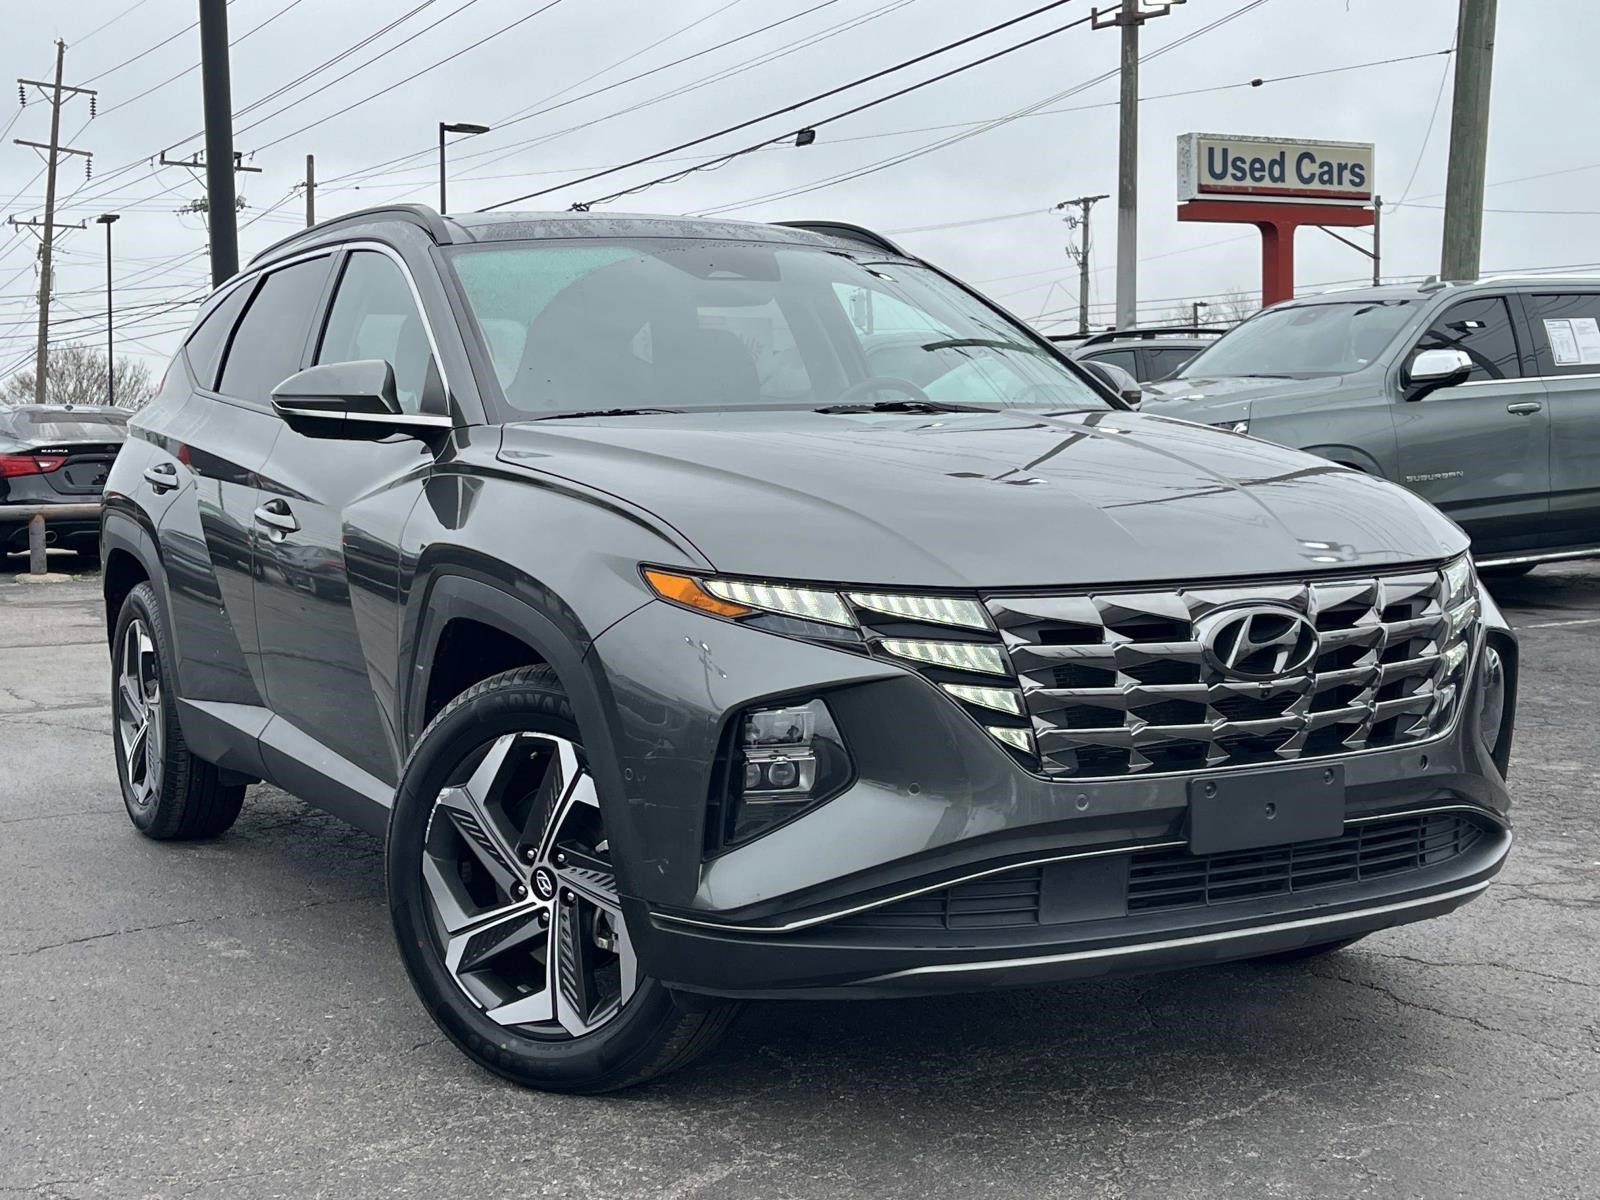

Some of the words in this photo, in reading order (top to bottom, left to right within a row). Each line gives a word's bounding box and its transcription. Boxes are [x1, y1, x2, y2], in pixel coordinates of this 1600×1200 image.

[1207, 146, 1286, 183] Used
[1295, 151, 1366, 187] Cars
[1405, 470, 1464, 482] SUBURBAN
